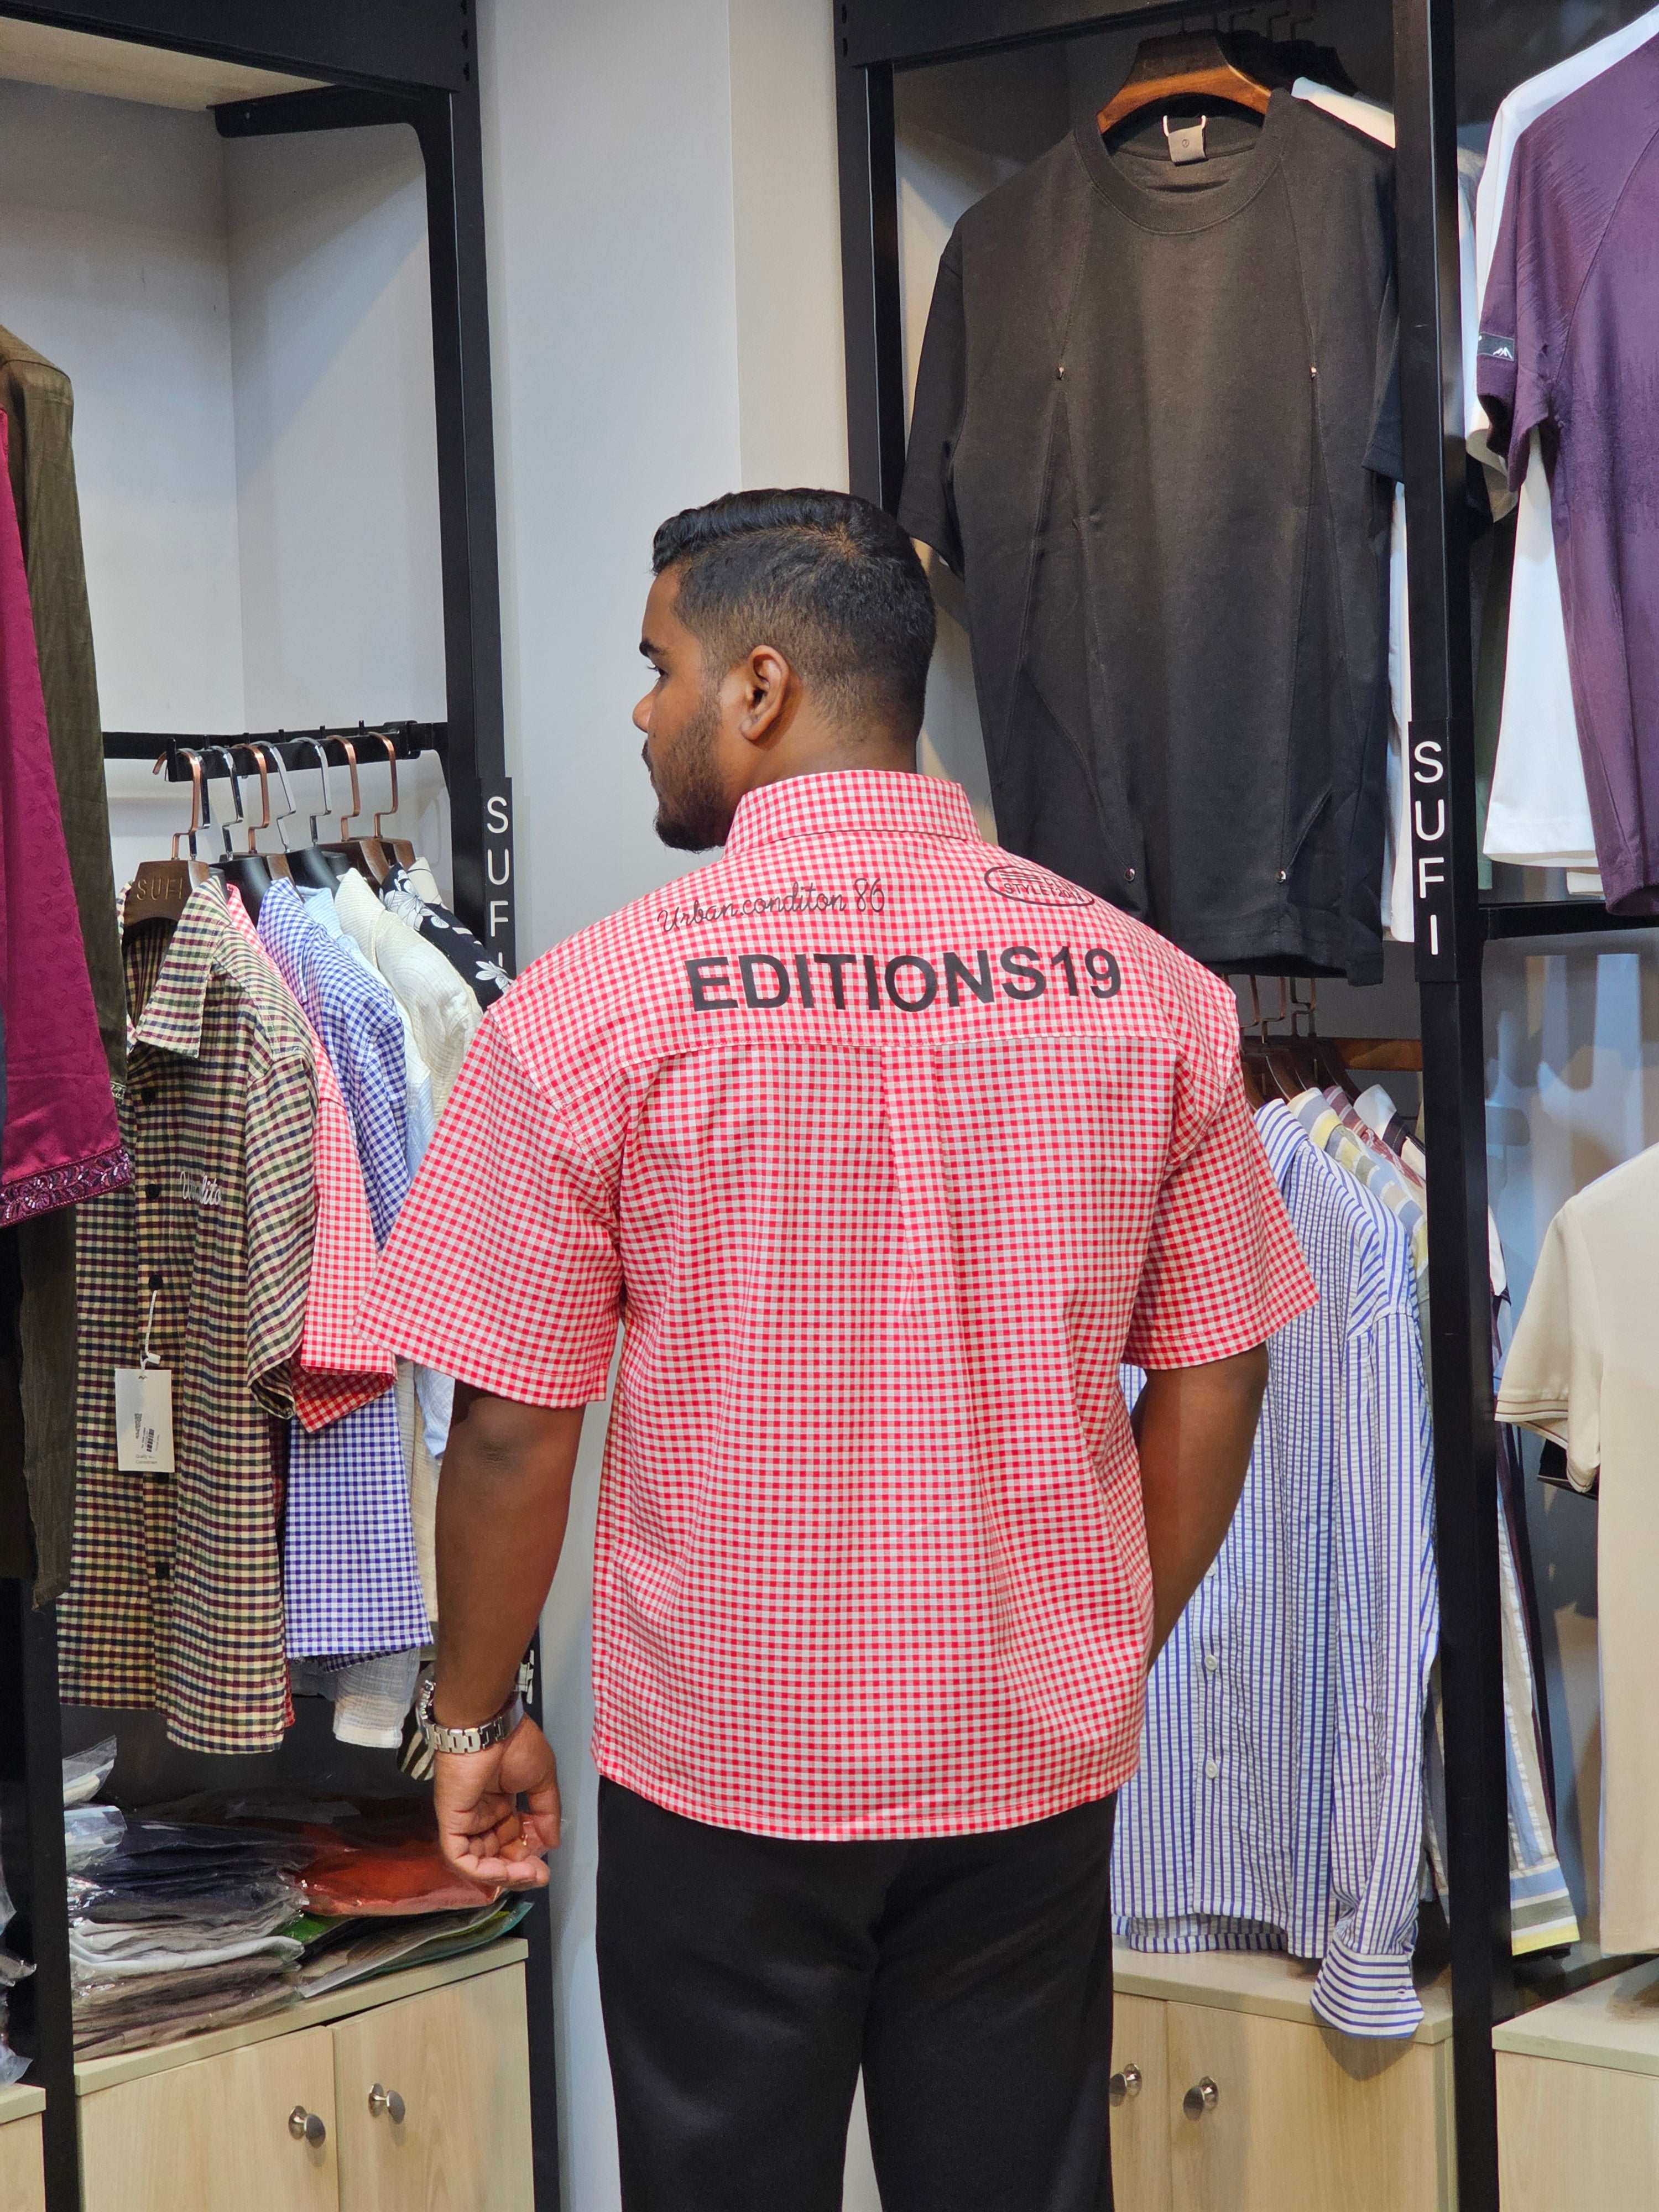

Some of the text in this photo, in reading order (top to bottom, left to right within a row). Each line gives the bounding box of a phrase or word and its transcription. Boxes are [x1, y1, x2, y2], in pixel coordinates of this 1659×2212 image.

[1413, 740, 1446, 956] SUFI
[137, 877, 183, 901] SUFI
[854, 877, 885, 913] 86
[685, 945, 1121, 1013] EDITIONS19
